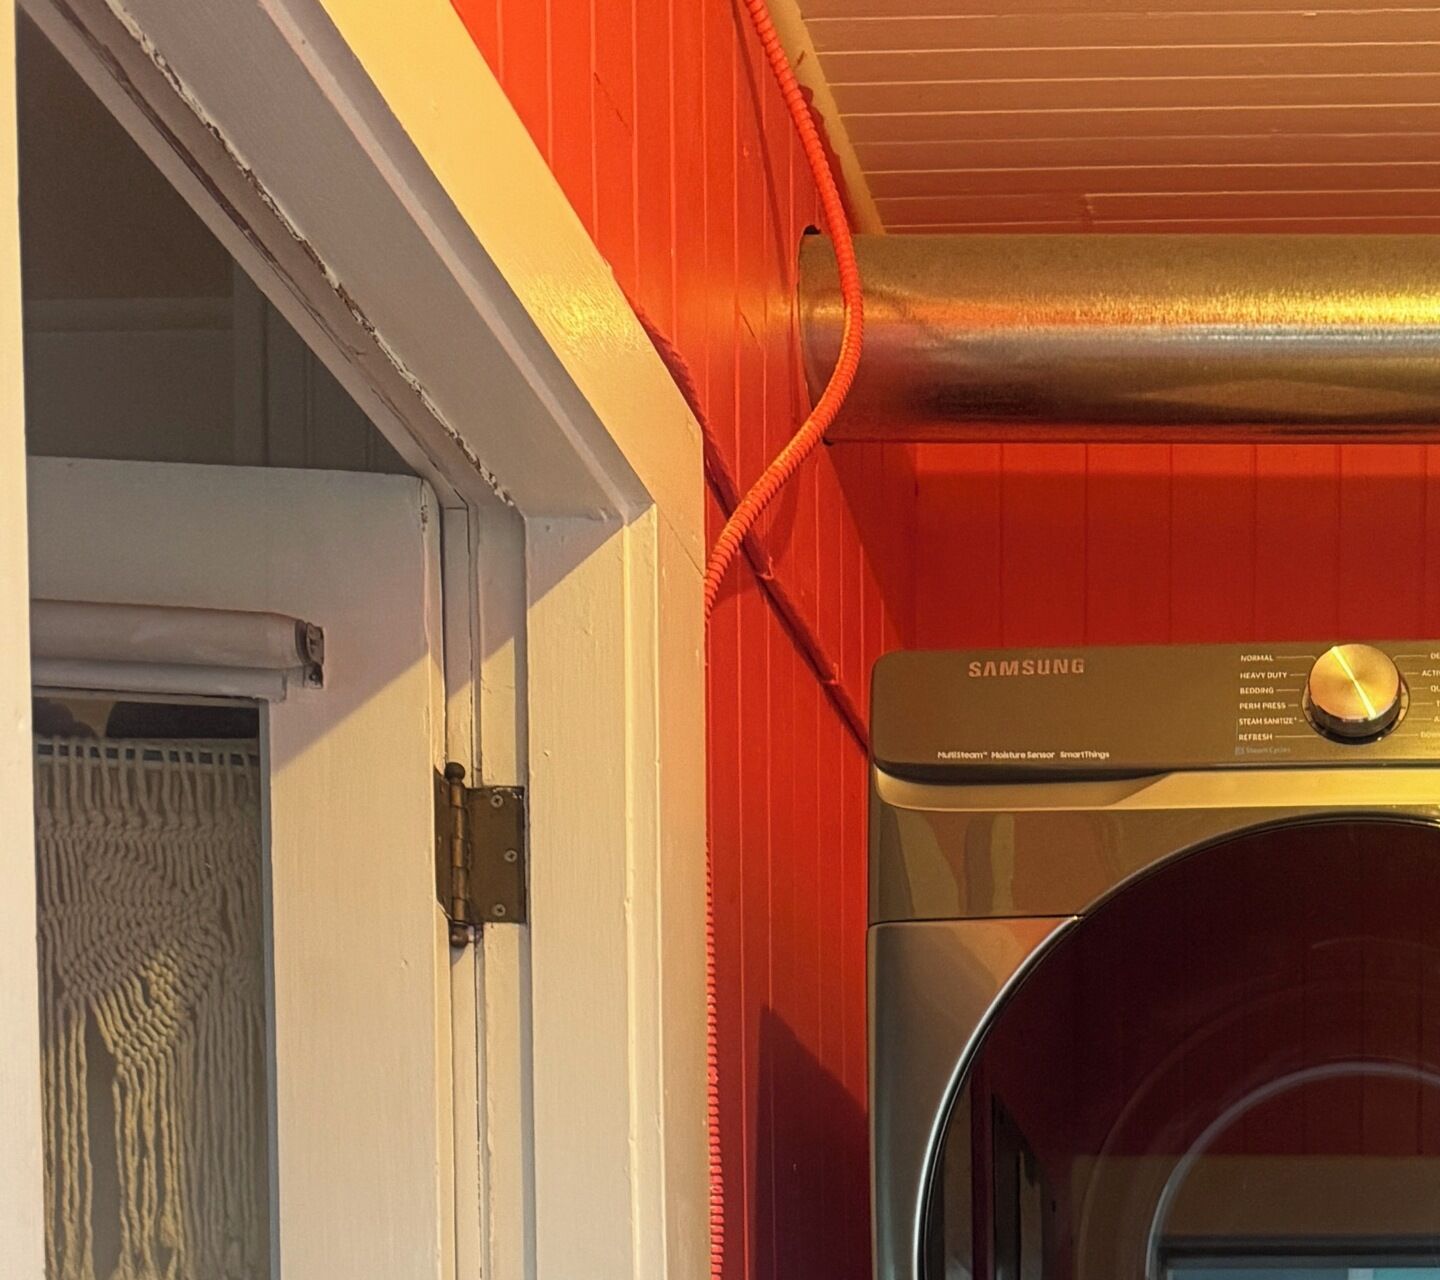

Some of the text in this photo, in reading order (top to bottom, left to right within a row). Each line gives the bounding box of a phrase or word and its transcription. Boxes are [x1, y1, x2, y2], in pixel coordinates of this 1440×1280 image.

[1240, 654, 1274, 662] NORMAL
[967, 658, 1085, 678] SAMSUNG
[1239, 671, 1288, 679] HEAVY DUTY
[1239, 686, 1274, 695] BEDDING
[1239, 701, 1287, 710] PERM PRESS
[1239, 717, 1262, 725] STEAM
[1238, 733, 1273, 741] REFRESH
[990, 751, 1026, 760] Moisture
[1026, 751, 1056, 760] Sensor
[1059, 751, 1111, 760] SmartThings
